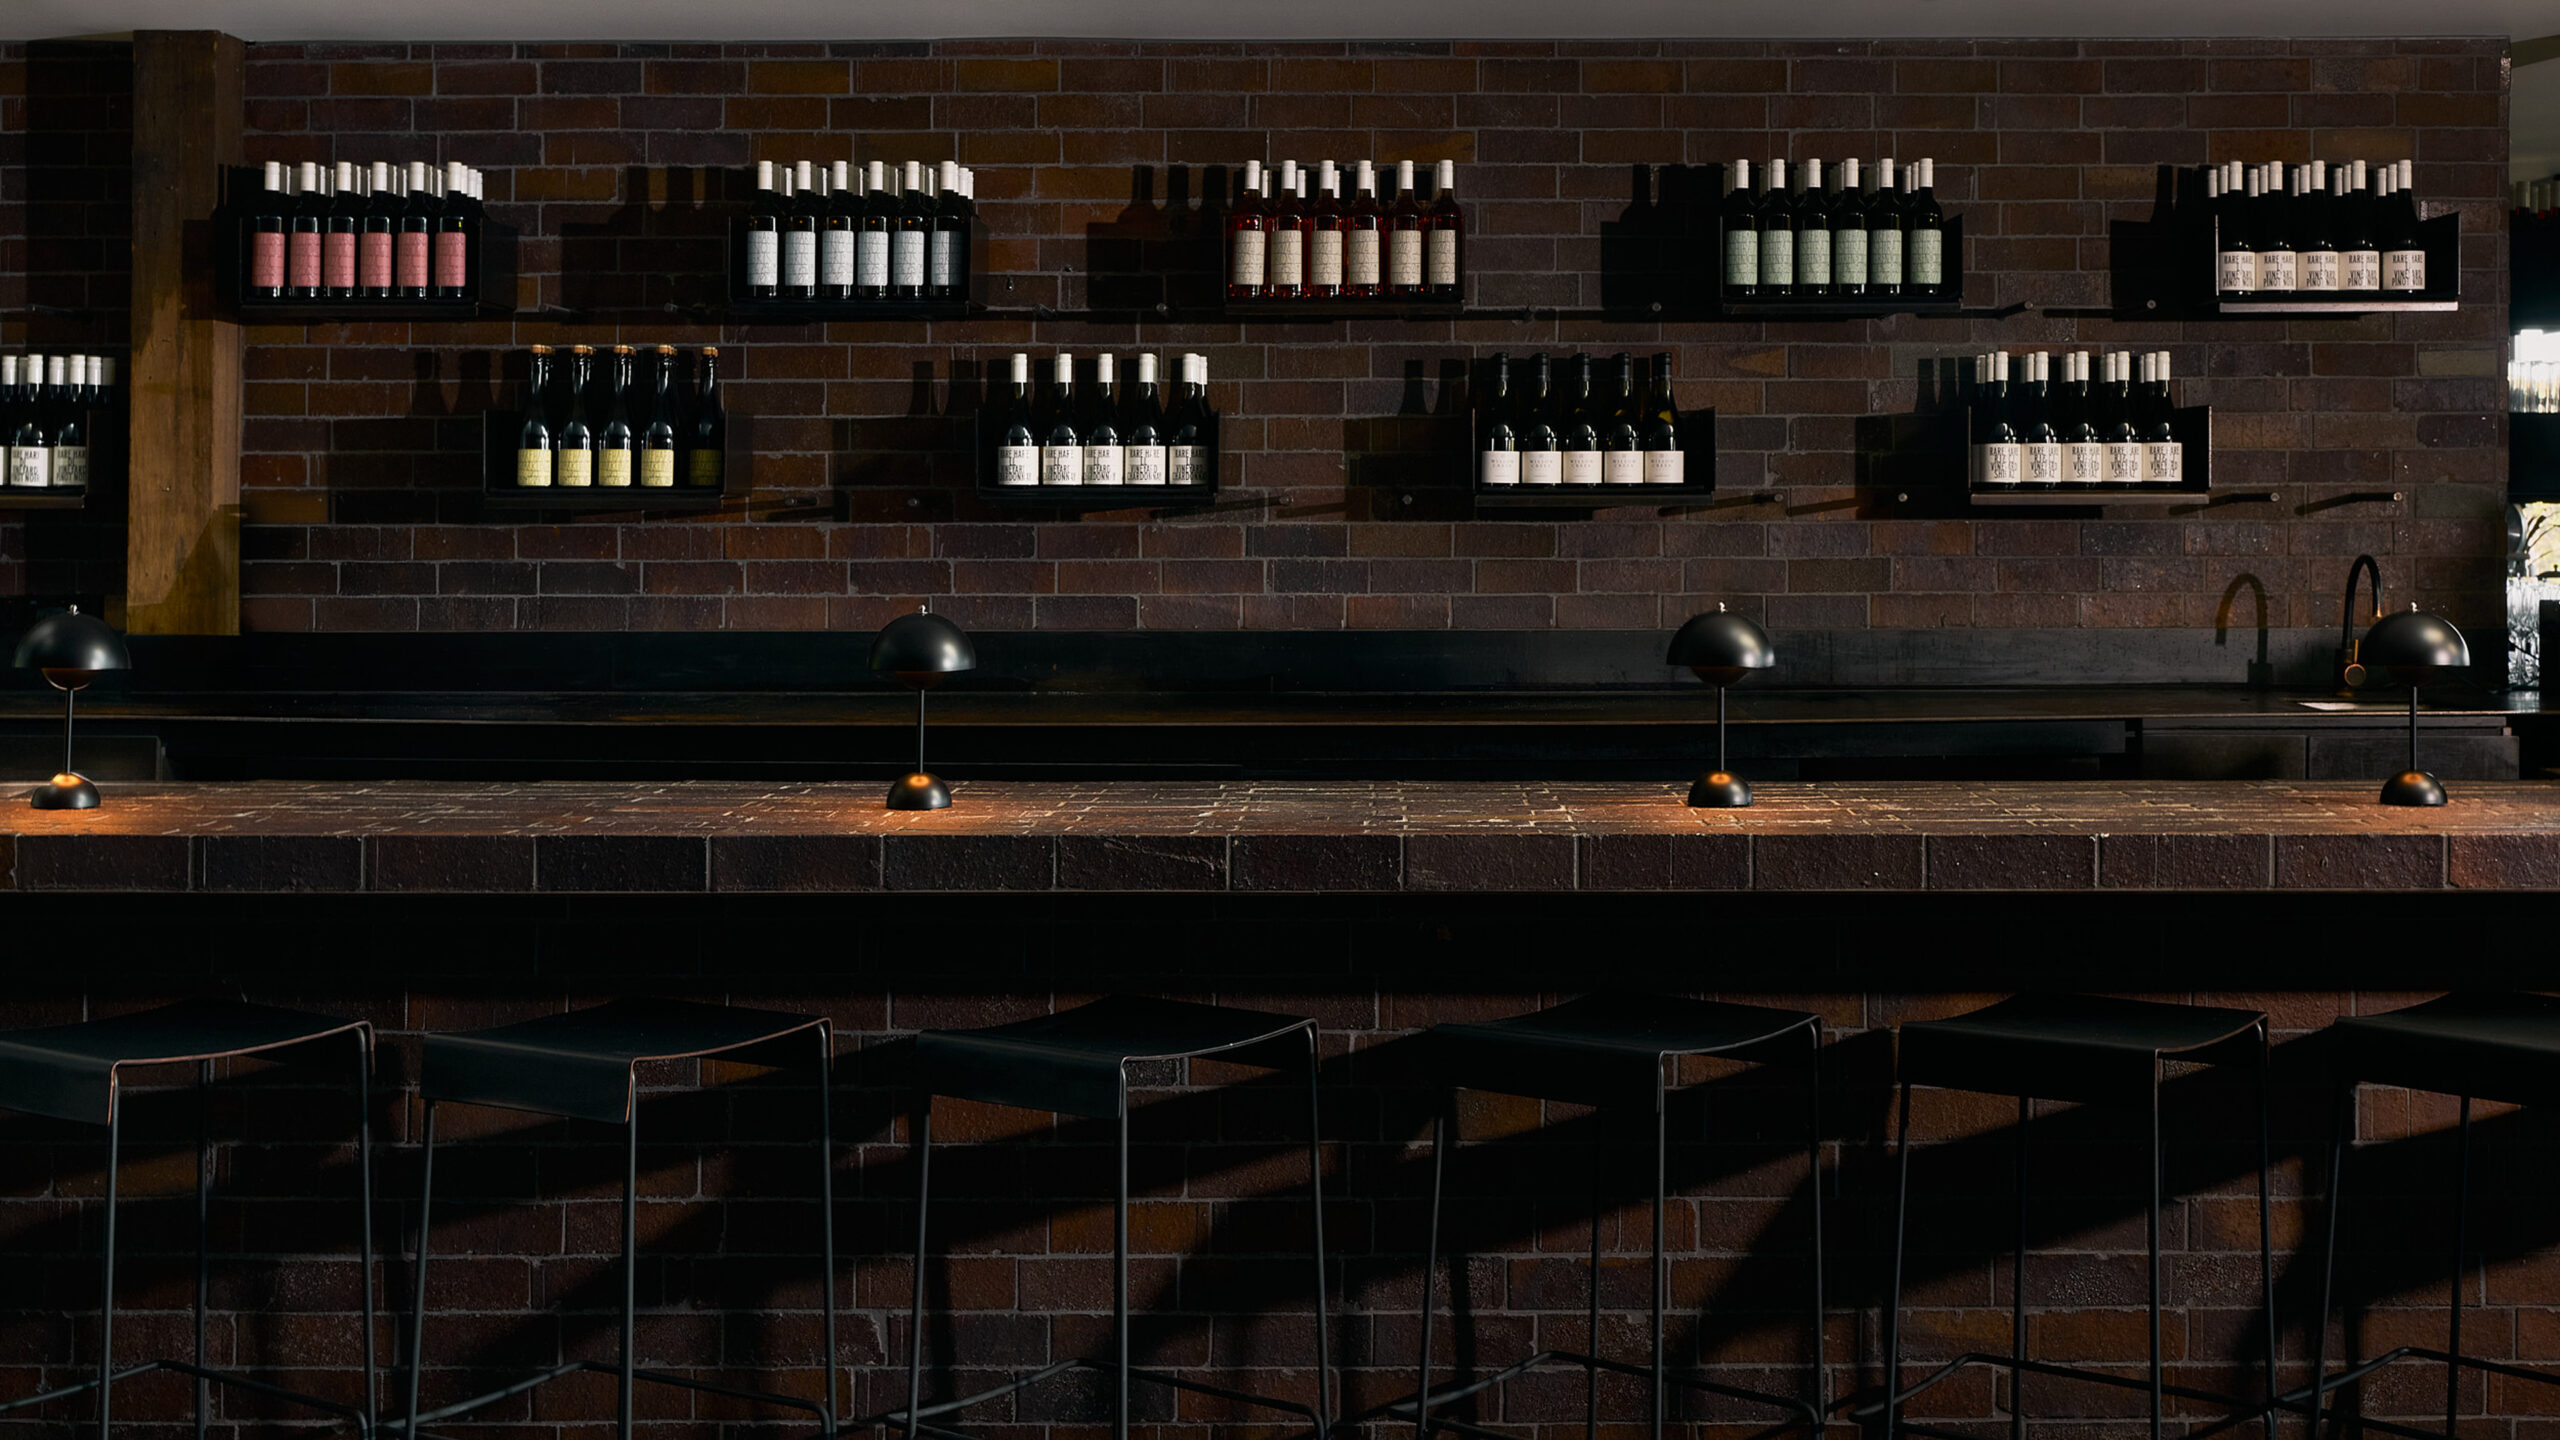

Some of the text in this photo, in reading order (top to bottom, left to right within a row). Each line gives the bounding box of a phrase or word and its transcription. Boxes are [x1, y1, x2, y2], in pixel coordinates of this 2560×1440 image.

[2224, 255, 2239, 264] RARE
[2264, 255, 2279, 264] RARE
[2307, 255, 2322, 264] RARE
[2349, 255, 2364, 263] RARE
[2392, 255, 2408, 263] RARE
[73, 450, 86, 458] HAR
